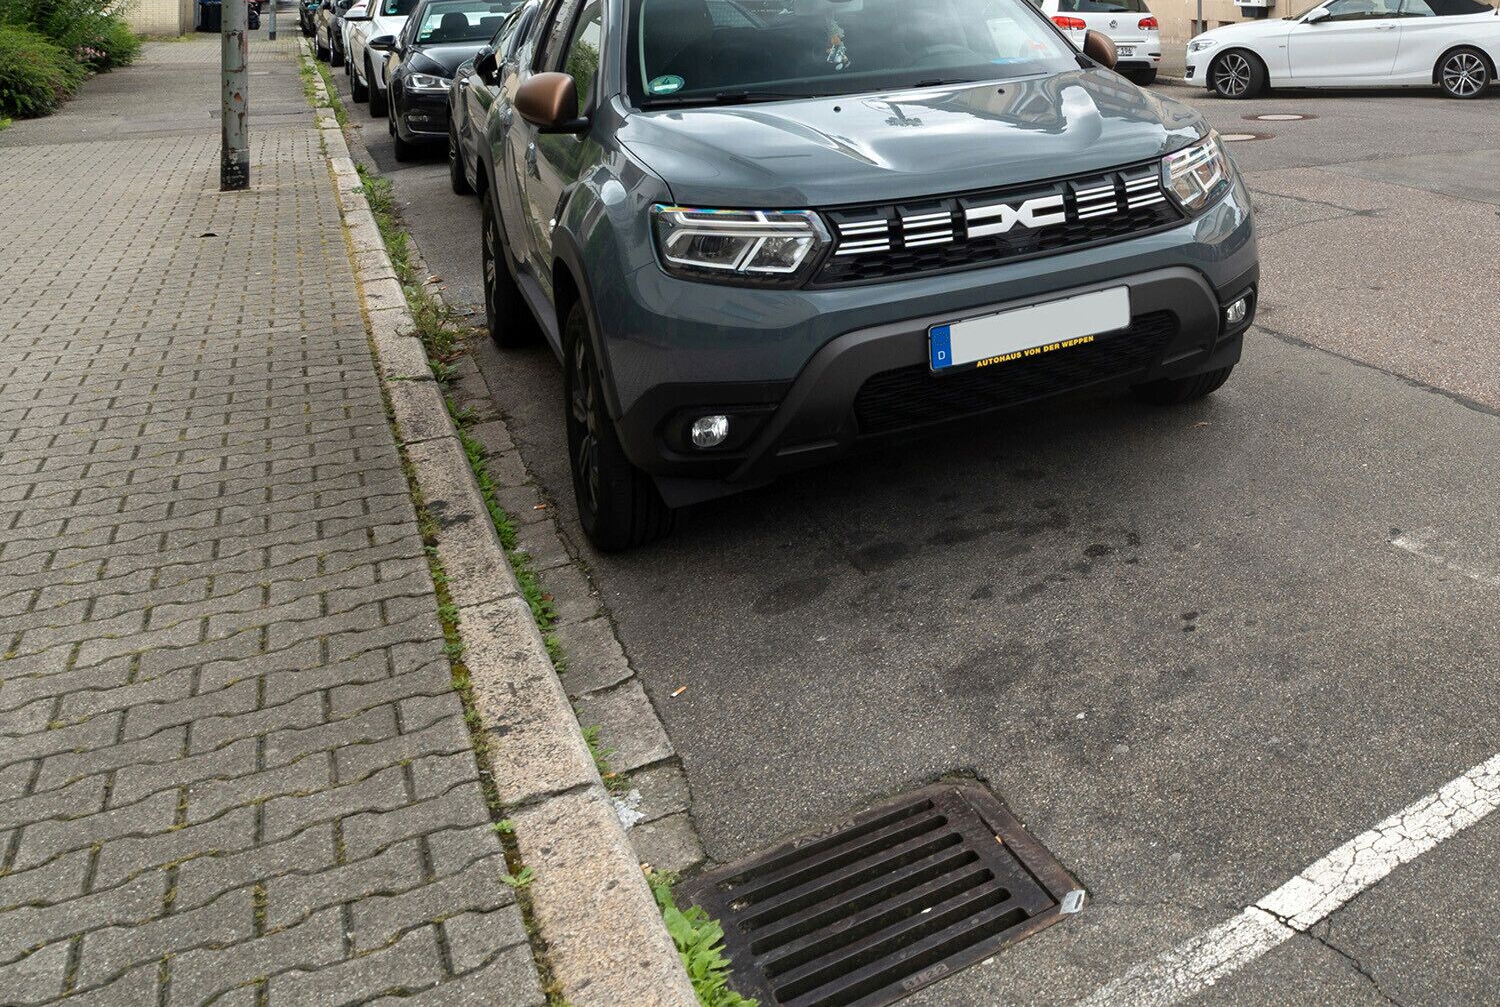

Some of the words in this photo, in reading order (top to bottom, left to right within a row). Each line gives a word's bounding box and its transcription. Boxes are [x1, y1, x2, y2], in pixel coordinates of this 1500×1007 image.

[938, 350, 946, 360] D
[976, 352, 1022, 368] AUTOHAUS
[1024, 347, 1042, 357] VON
[1043, 343, 1060, 353] DER
[1061, 335, 1094, 348] WEPPEN
